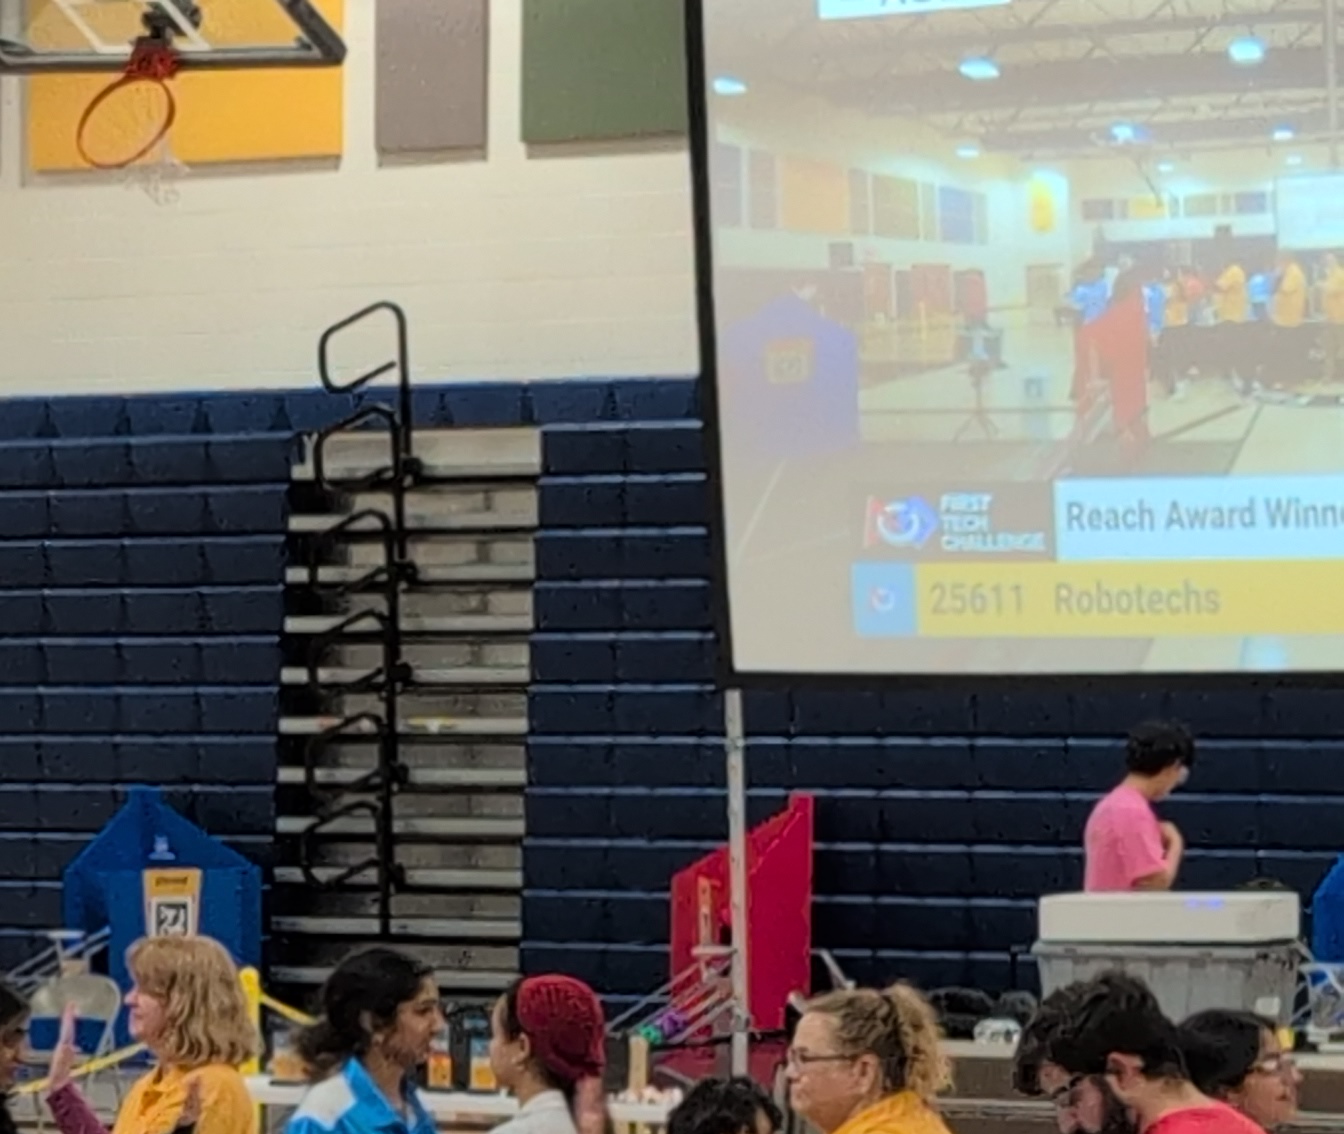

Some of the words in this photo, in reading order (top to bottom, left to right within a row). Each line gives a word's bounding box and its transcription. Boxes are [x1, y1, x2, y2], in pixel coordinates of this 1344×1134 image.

[1066, 500, 1154, 532] Reach
[1164, 498, 1256, 530] Award
[930, 582, 1025, 615] 25611
[1054, 581, 1222, 616] Robotechs
